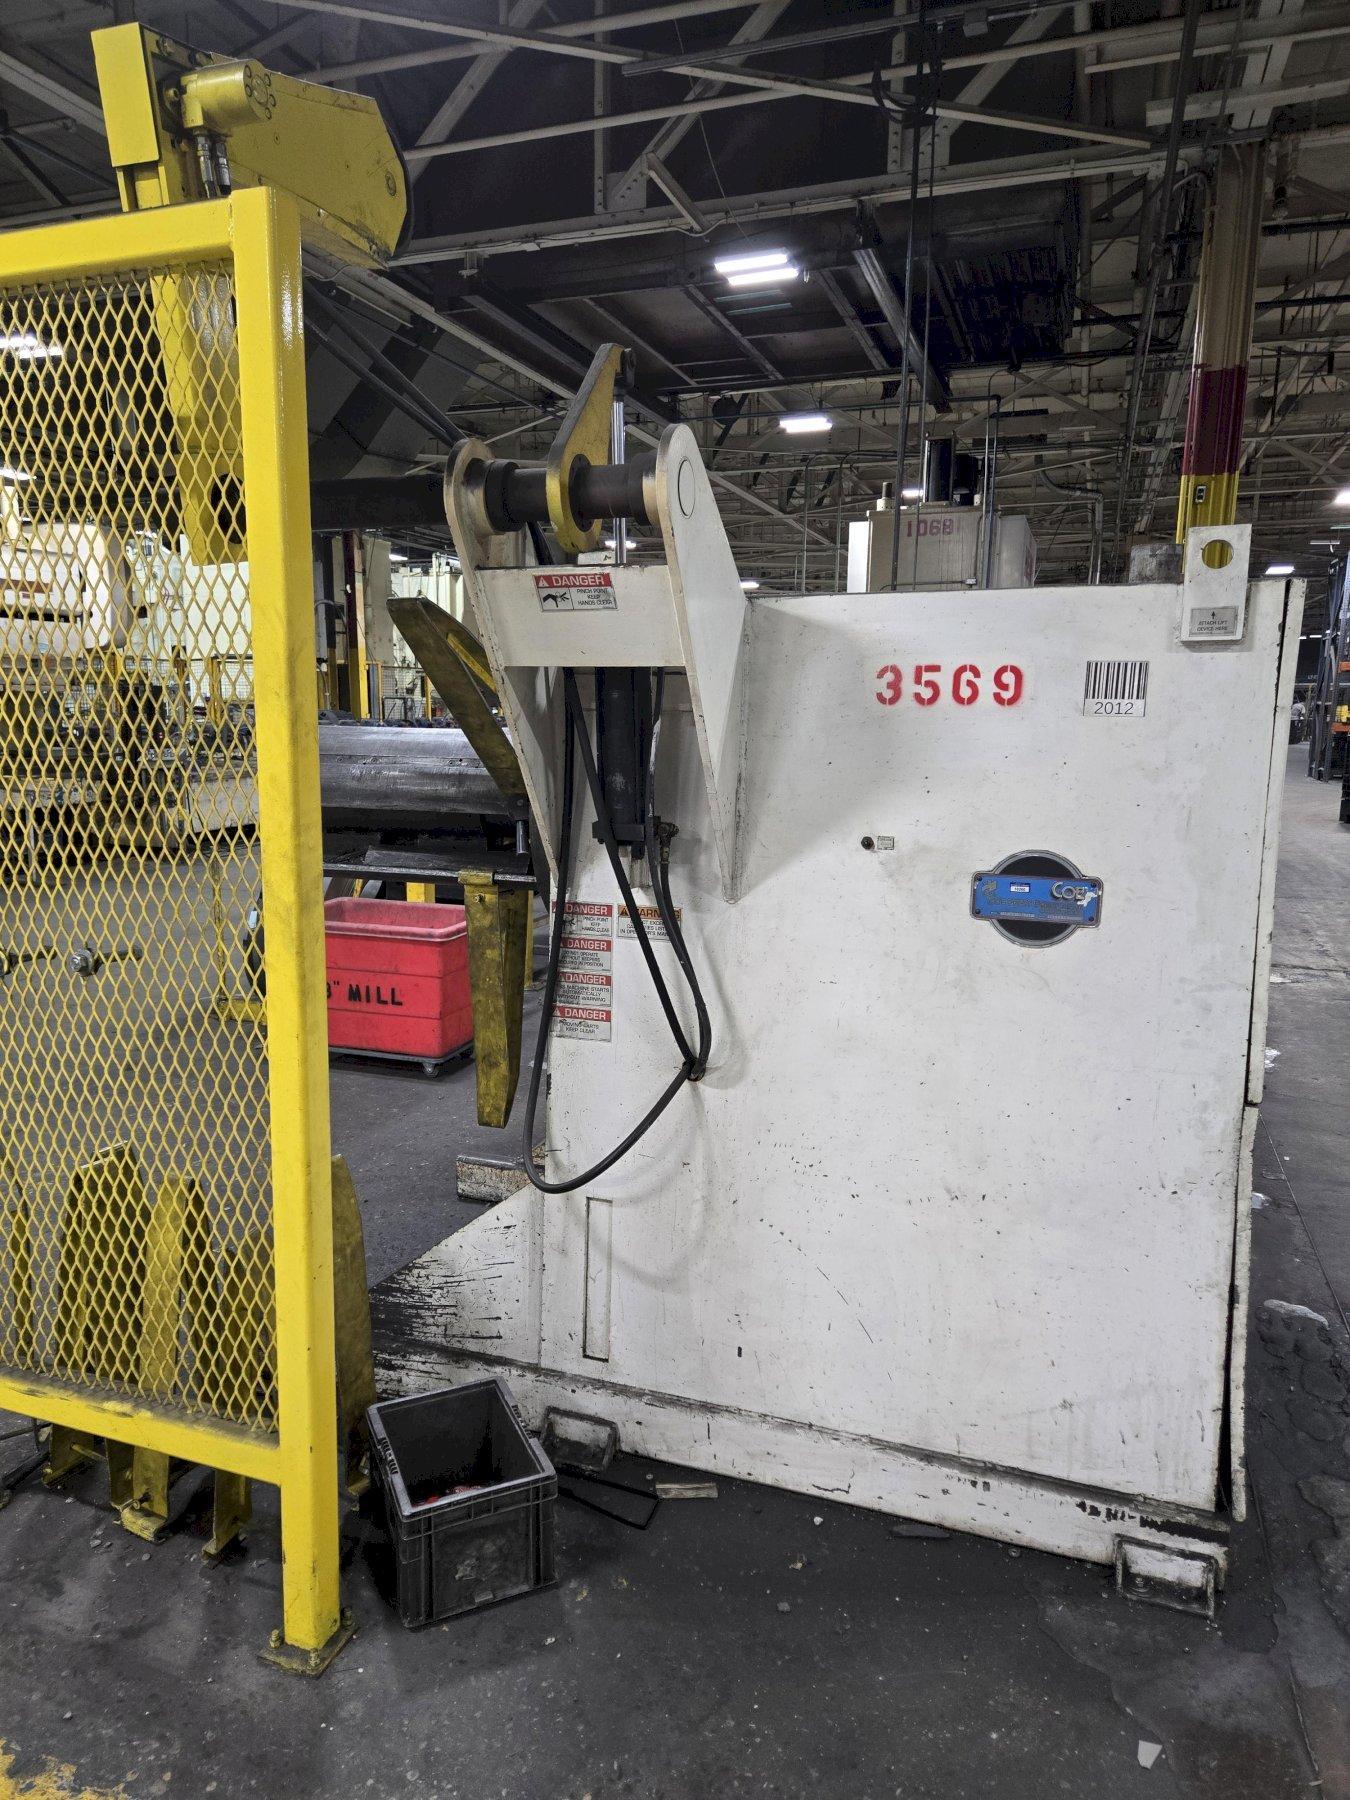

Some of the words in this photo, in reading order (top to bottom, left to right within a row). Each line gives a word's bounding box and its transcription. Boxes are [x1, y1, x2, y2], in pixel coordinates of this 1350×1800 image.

[552, 575, 605, 586] DANGER
[876, 664, 1024, 706] 3569
[1093, 701, 1135, 716] 2012
[565, 904, 608, 915] DANGER
[567, 939, 607, 950] DANGER
[565, 973, 606, 985] DANGER
[348, 983, 403, 1006] MILL
[564, 1008, 606, 1020] DANGER
